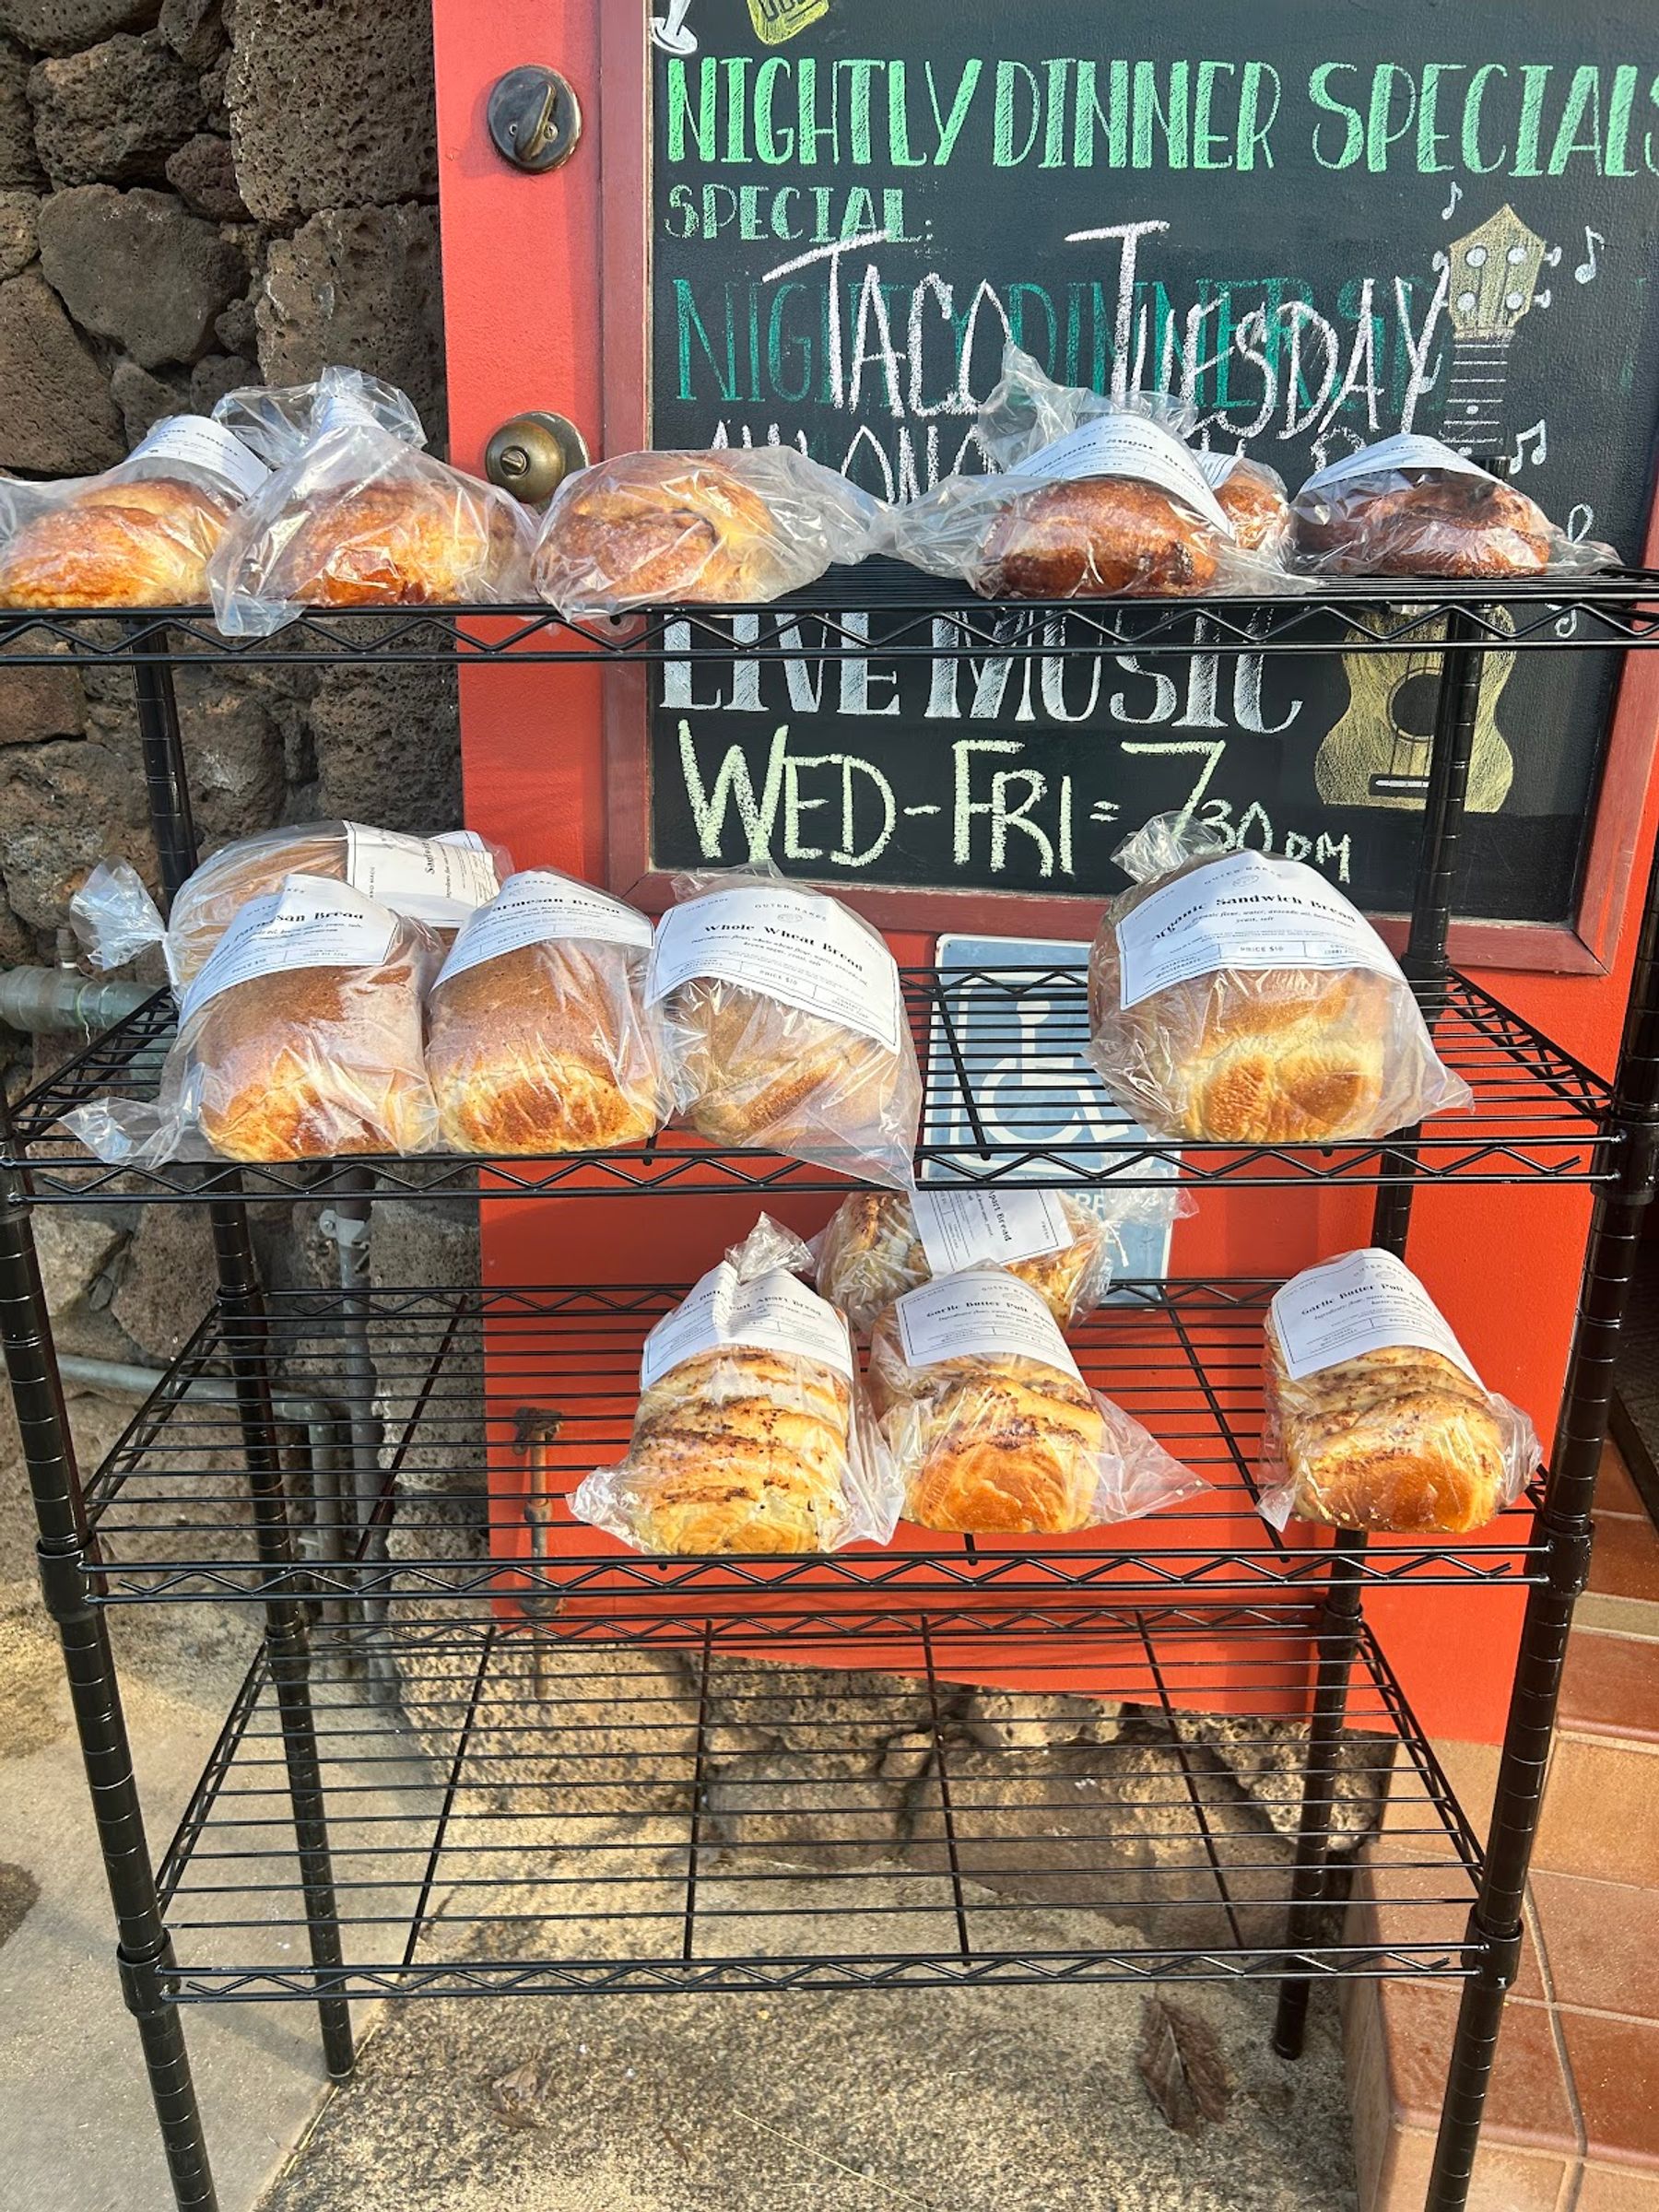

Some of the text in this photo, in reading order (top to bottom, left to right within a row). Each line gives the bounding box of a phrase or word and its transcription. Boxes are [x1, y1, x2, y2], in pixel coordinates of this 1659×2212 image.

[667, 56, 1659, 177] NIGHTLY DINNER SPECIAL
[761, 229, 1013, 418] TACO
[1064, 219, 1451, 441] TUESDAY
[660, 609, 1304, 734] LIVE MUSIC
[704, 924, 756, 933] Whole
[763, 925, 815, 947] Wheat
[1216, 894, 1303, 906] Sandwich
